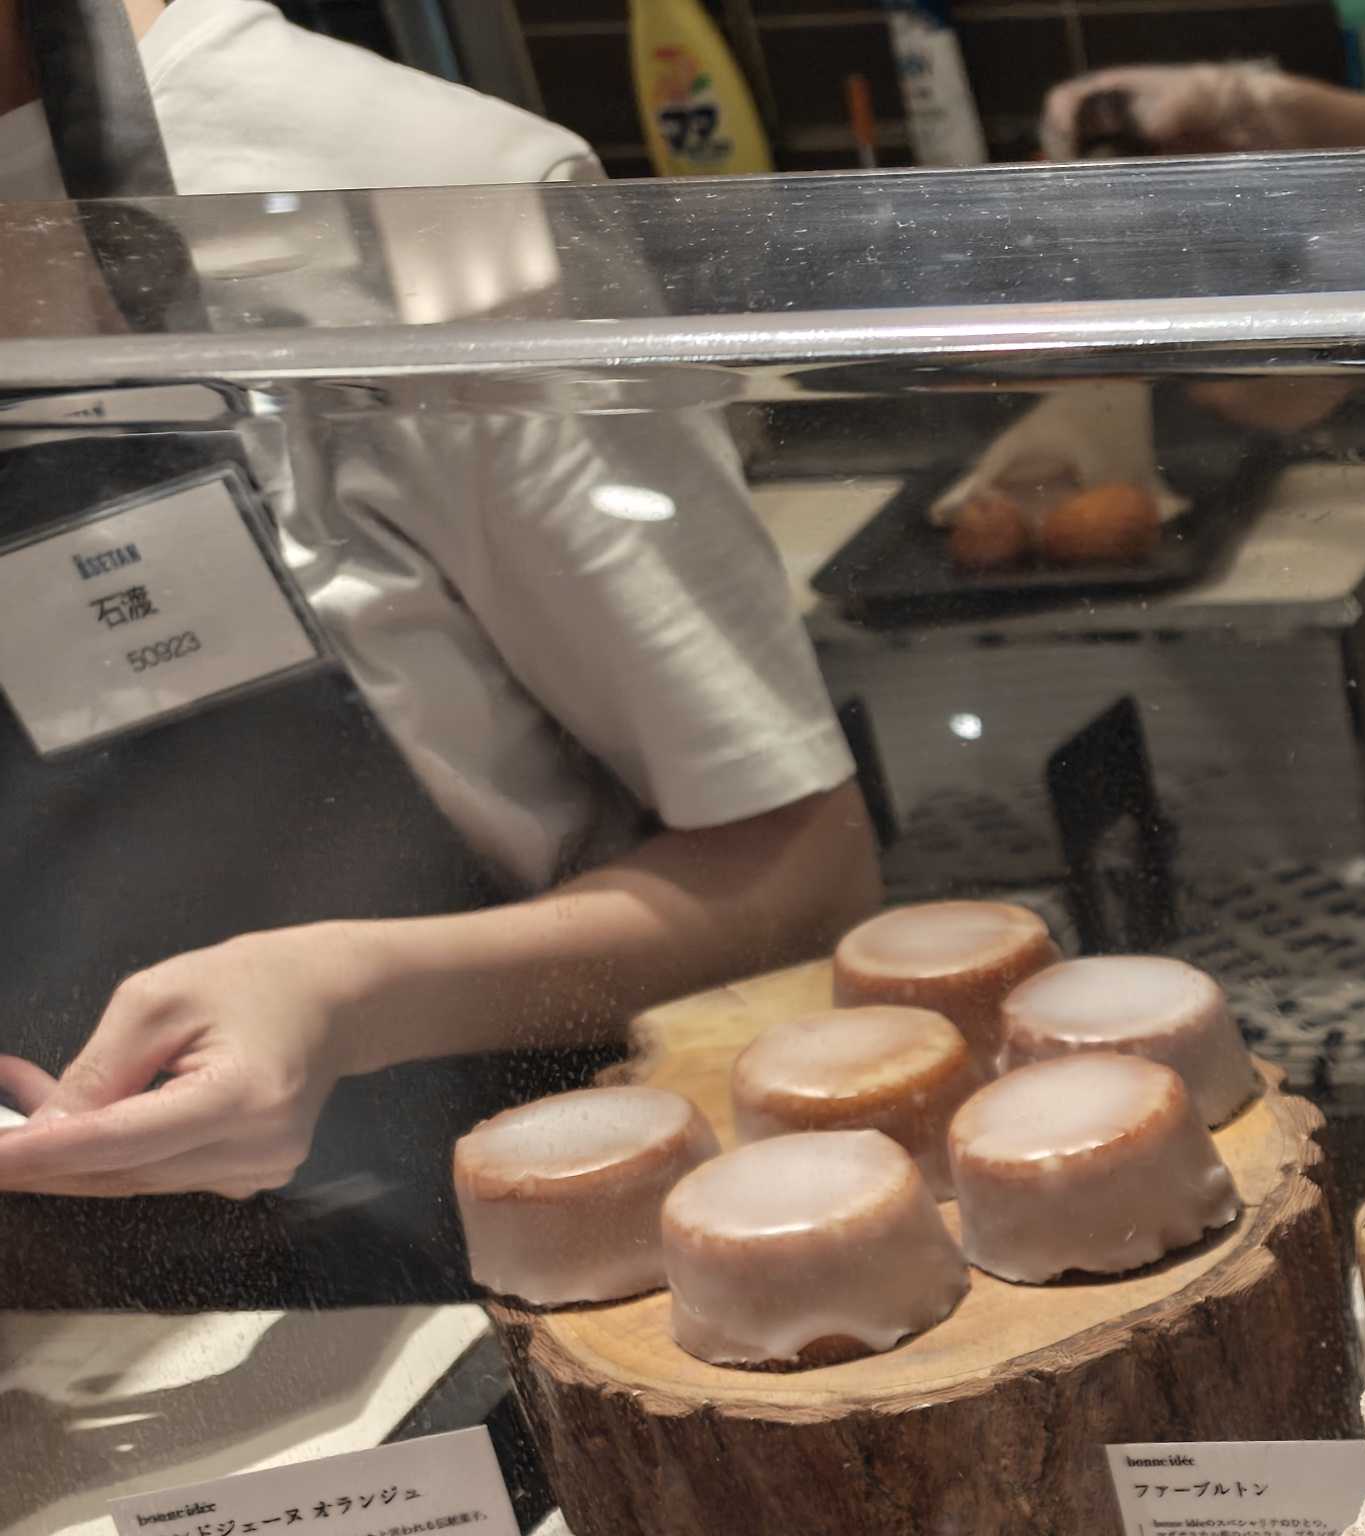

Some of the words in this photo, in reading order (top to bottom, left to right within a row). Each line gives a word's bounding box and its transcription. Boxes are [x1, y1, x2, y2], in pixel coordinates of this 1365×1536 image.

[1134, 1481, 1268, 1498] ファーブルトン
[313, 1487, 420, 1518] オランジュ
